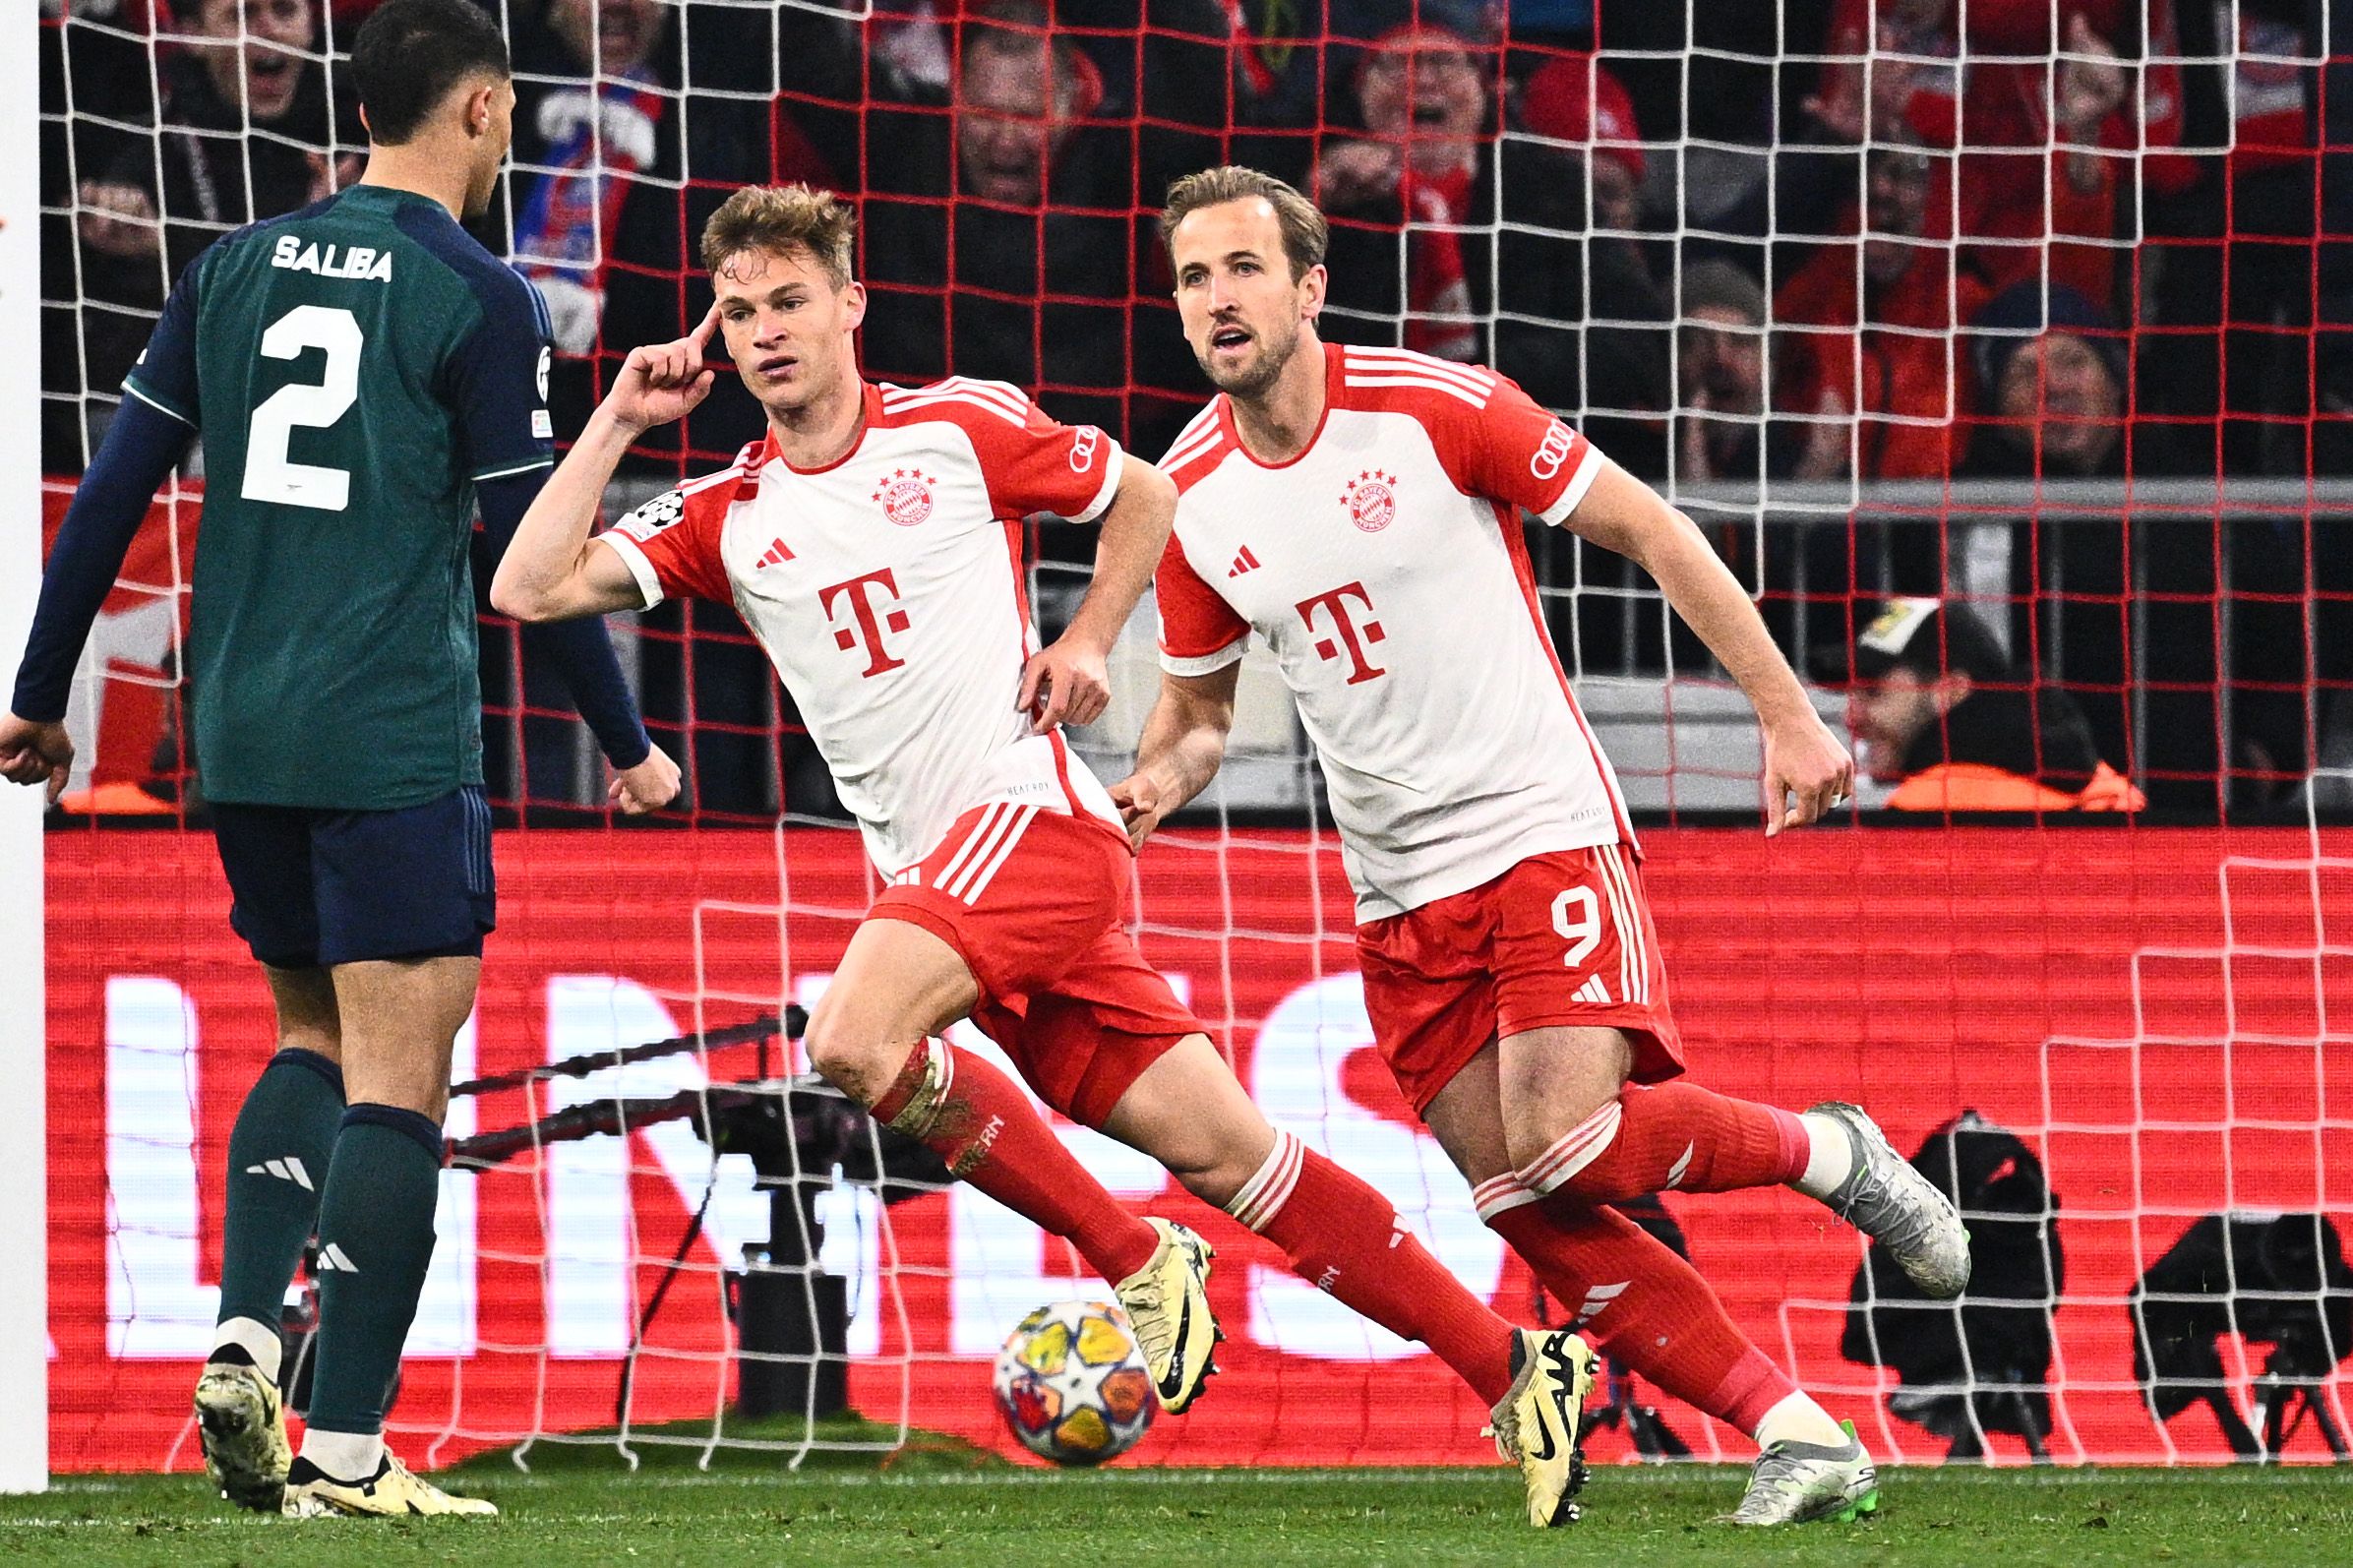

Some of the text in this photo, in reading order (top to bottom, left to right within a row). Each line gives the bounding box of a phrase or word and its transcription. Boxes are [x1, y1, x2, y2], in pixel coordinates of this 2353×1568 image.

[271, 235, 392, 283] SALIBA
[240, 304, 364, 512] 2
[1551, 884, 1601, 968] 9
[45, 971, 1505, 1360] LINES
